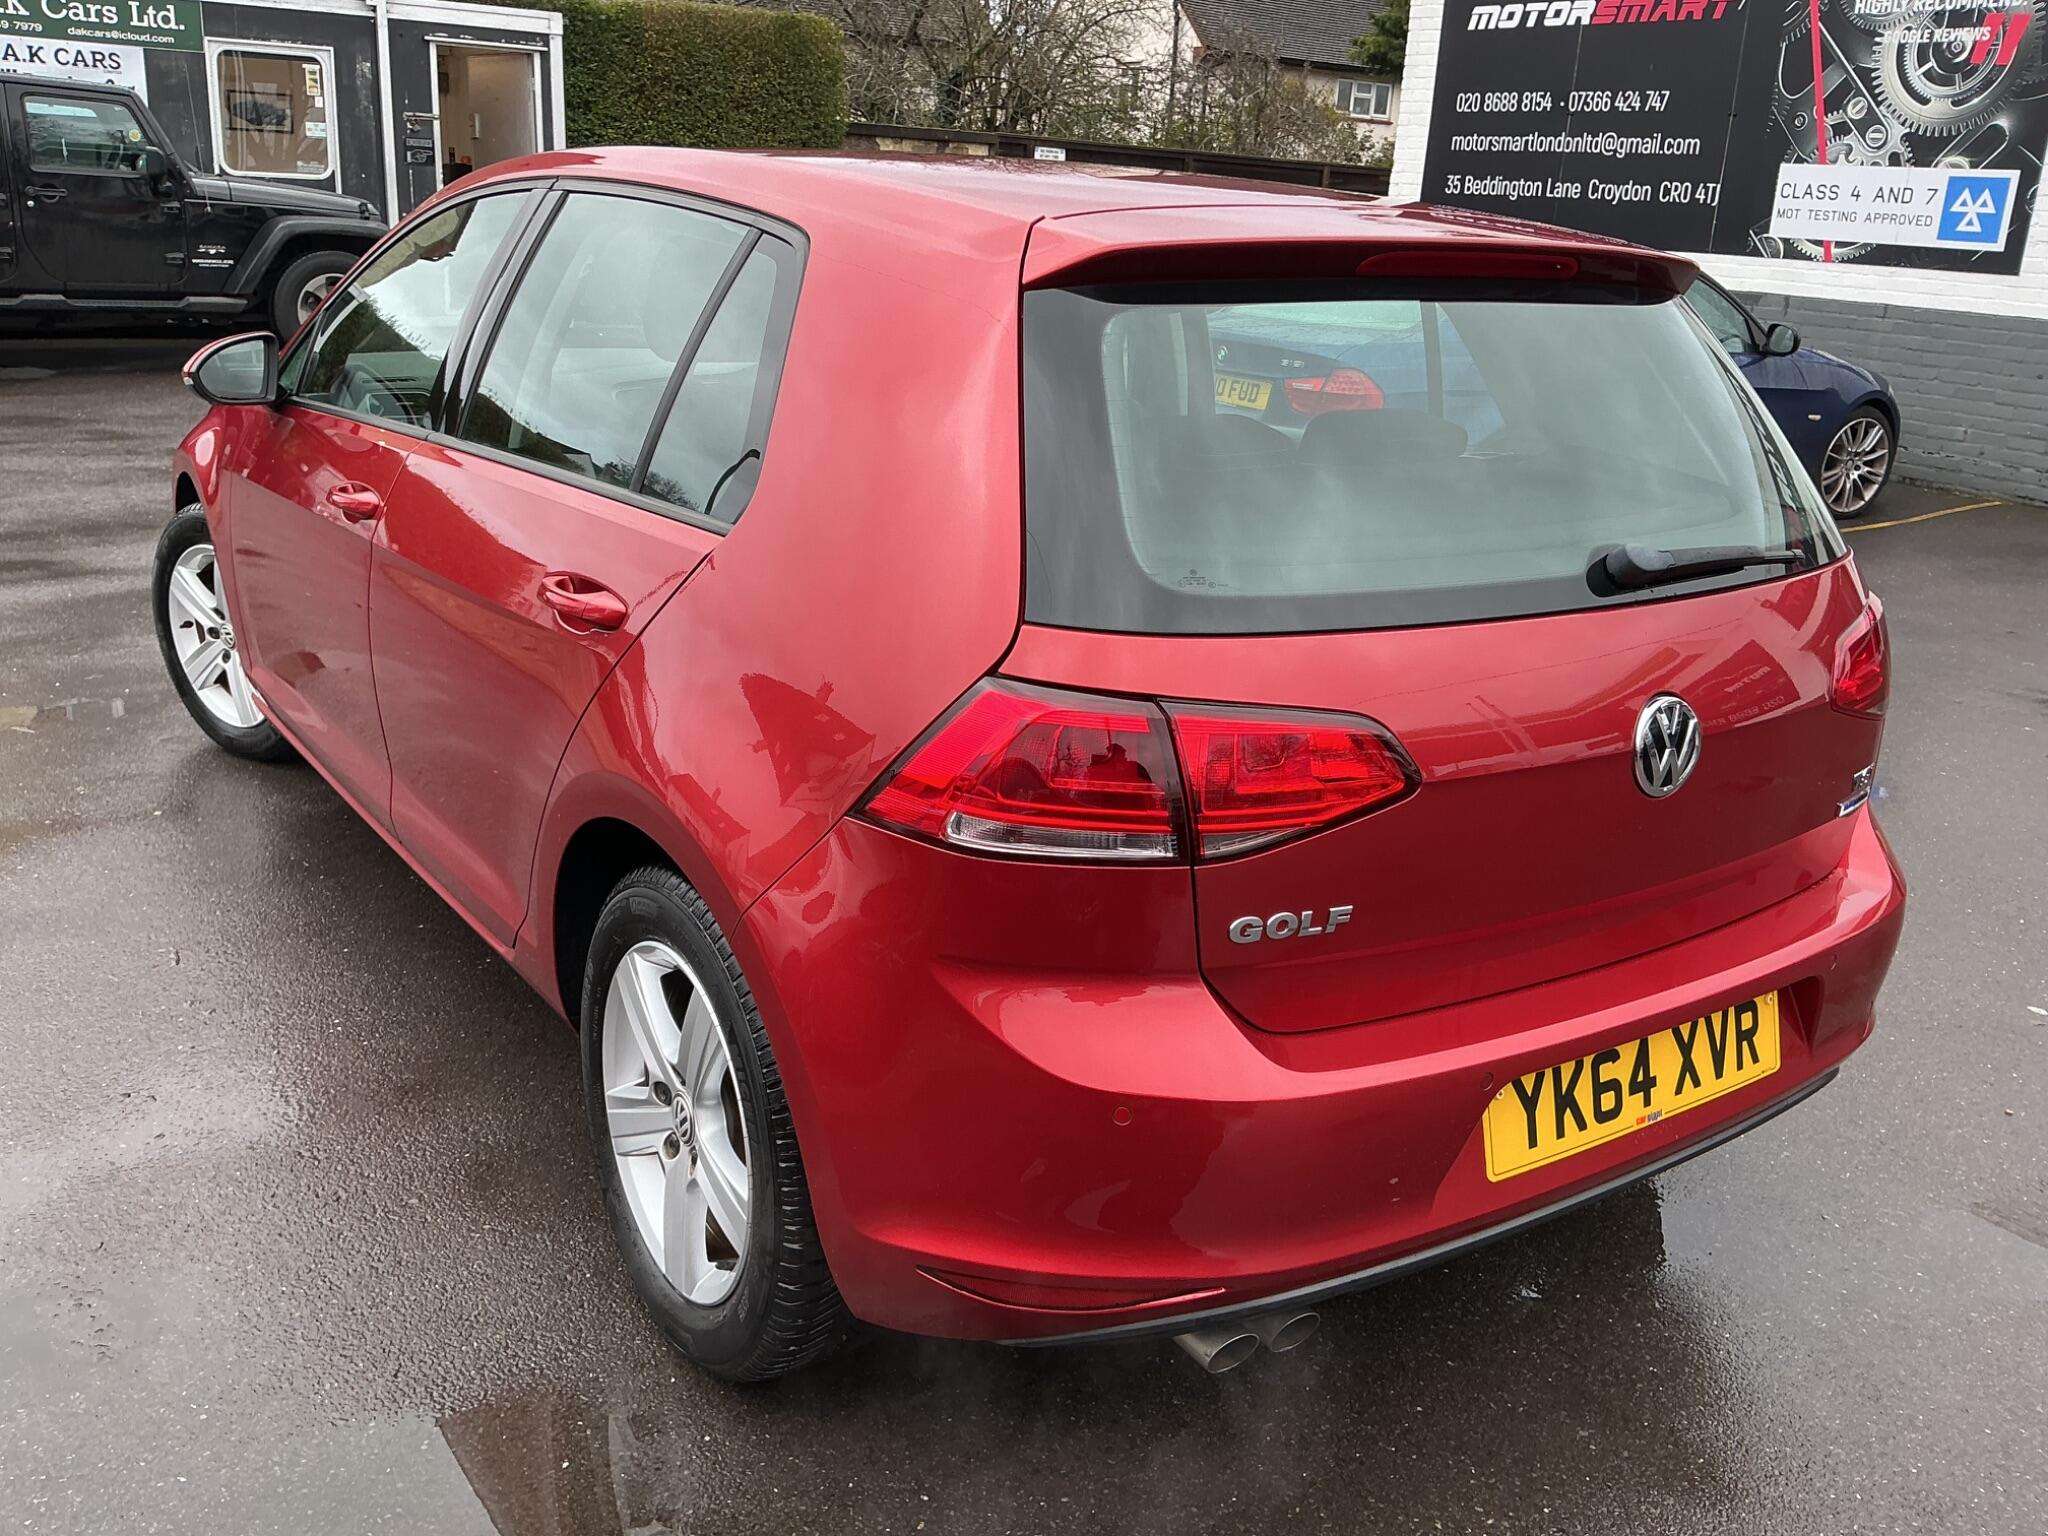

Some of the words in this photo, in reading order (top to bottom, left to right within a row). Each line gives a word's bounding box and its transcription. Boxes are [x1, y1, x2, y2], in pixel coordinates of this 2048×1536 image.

[13, 21, 43, 32] 7979
[41, 0, 119, 24] Cars
[128, 1, 186, 31] Ltd.
[1467, 0, 1729, 31] MOTORSMART
[67, 27, 175, 44] dakcars@icloud.com
[1884, 29, 1932, 44] GOOGLE
[1933, 26, 1992, 43] REVIEWS
[54, 47, 121, 70] CARS
[1456, 92, 1481, 113] 020
[1483, 91, 1519, 112] 8688
[1521, 91, 1553, 112] 8154
[1568, 90, 1612, 113] 07366
[1614, 91, 1641, 112] 424
[1645, 90, 1670, 112] 747
[1451, 131, 1701, 159] motorsmartlondonltd@gmail.com
[1445, 175, 1461, 195] 35
[1464, 175, 1543, 201] Beddington
[1546, 177, 1581, 199] Lane
[1588, 178, 1652, 205] Croydon
[1695, 182, 1721, 206] 4TJ
[1780, 182, 1840, 201] CLASS
[1850, 185, 1862, 202] 4
[1872, 186, 1914, 205] AND
[1926, 188, 1939, 205] 7
[1776, 208, 1801, 220] MOT
[1808, 208, 1857, 223] TESTING
[1864, 212, 1933, 227] APPROVED
[1229, 904, 1354, 944] GOLF
[1511, 1036, 1657, 1150] YK64
[1671, 999, 1760, 1097] XVR
